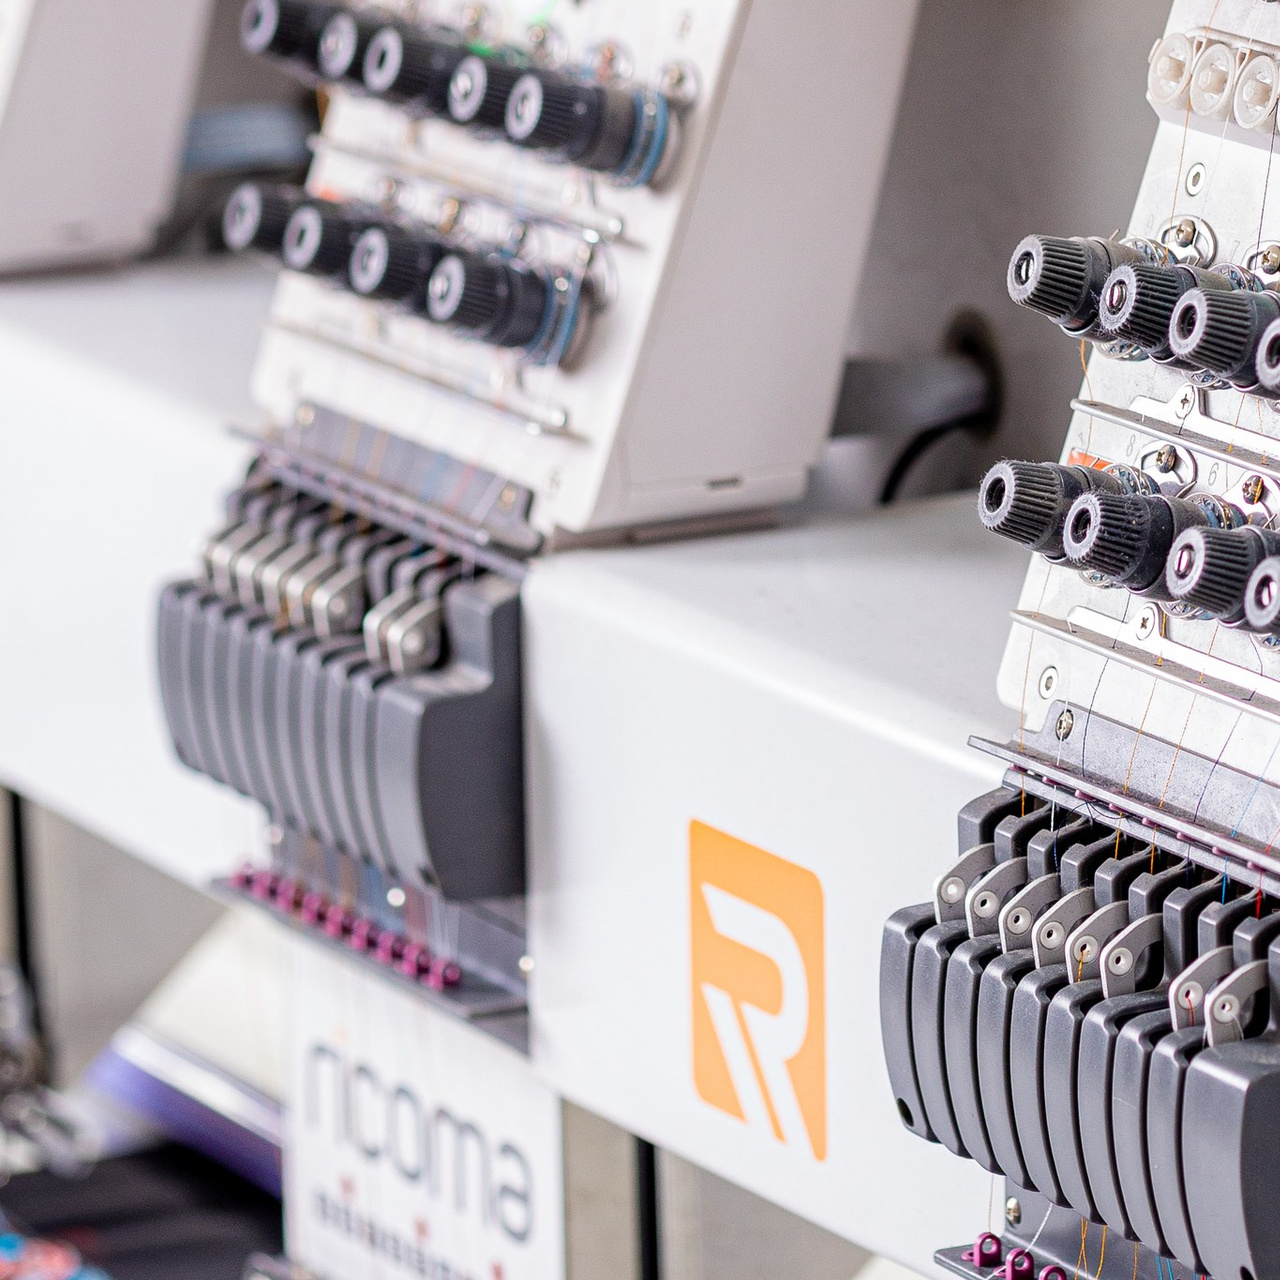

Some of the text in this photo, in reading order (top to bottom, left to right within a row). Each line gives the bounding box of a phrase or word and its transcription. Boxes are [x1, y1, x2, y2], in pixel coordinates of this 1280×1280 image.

[1230, 239, 1242, 263] 7
[1126, 433, 1137, 457] 8
[1207, 461, 1220, 487] 6
